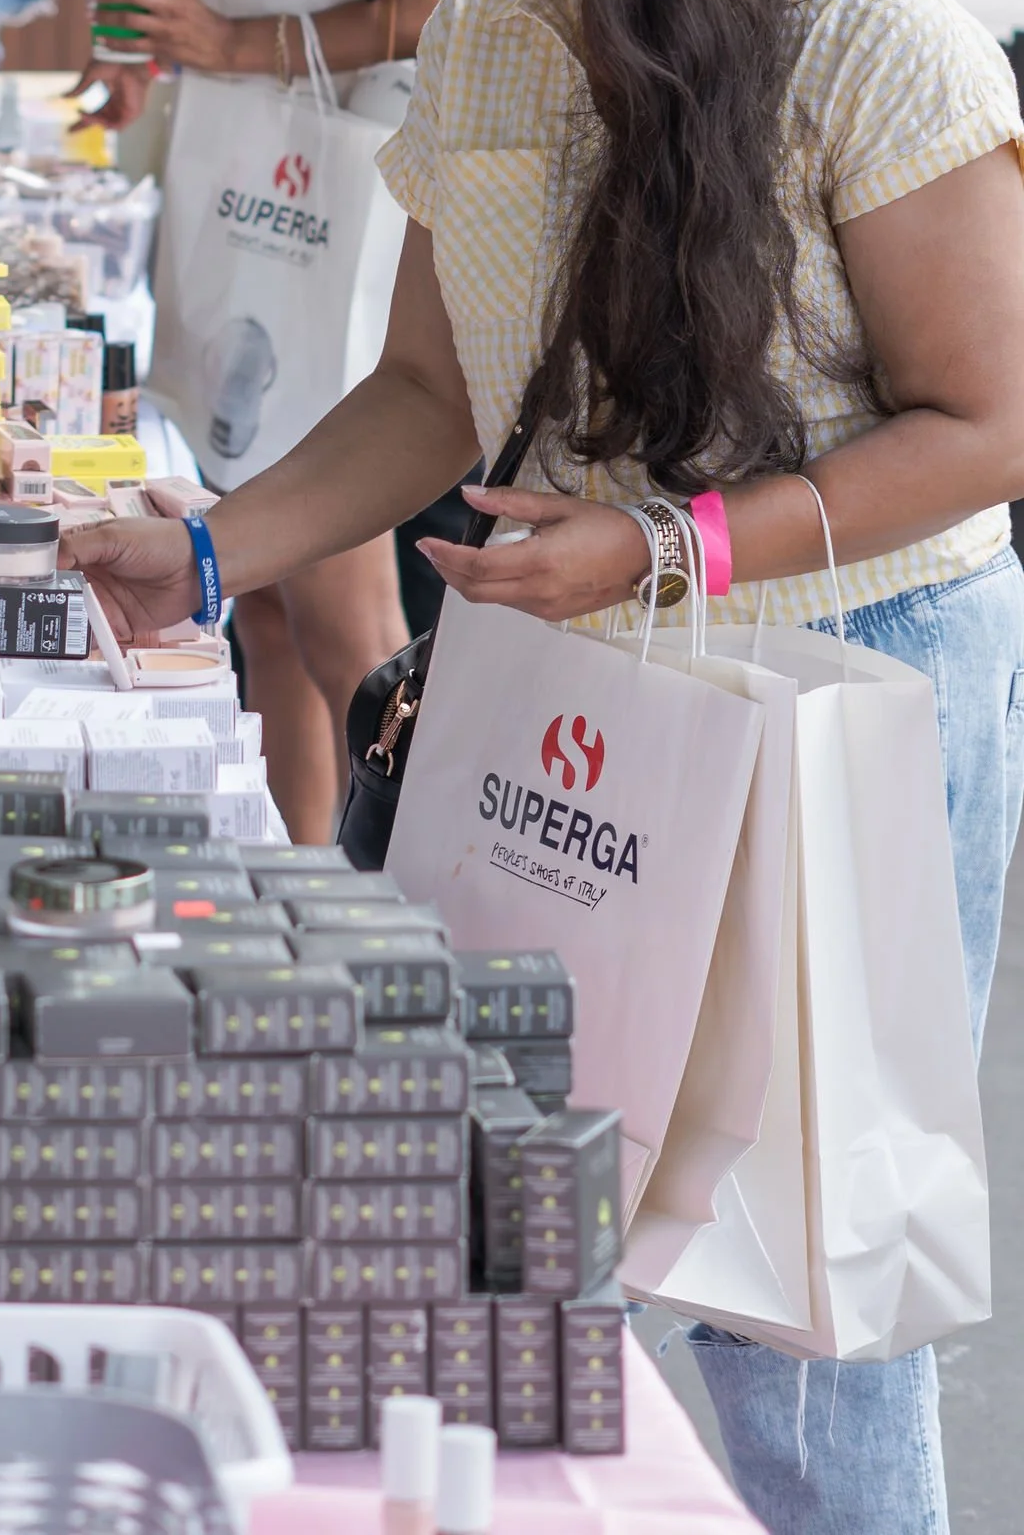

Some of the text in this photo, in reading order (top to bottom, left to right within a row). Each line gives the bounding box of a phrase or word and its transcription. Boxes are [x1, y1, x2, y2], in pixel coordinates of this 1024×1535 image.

[217, 187, 330, 249] SUPERGA
[529, 861, 561, 887] SHOES
[577, 880, 608, 911] ITALY
